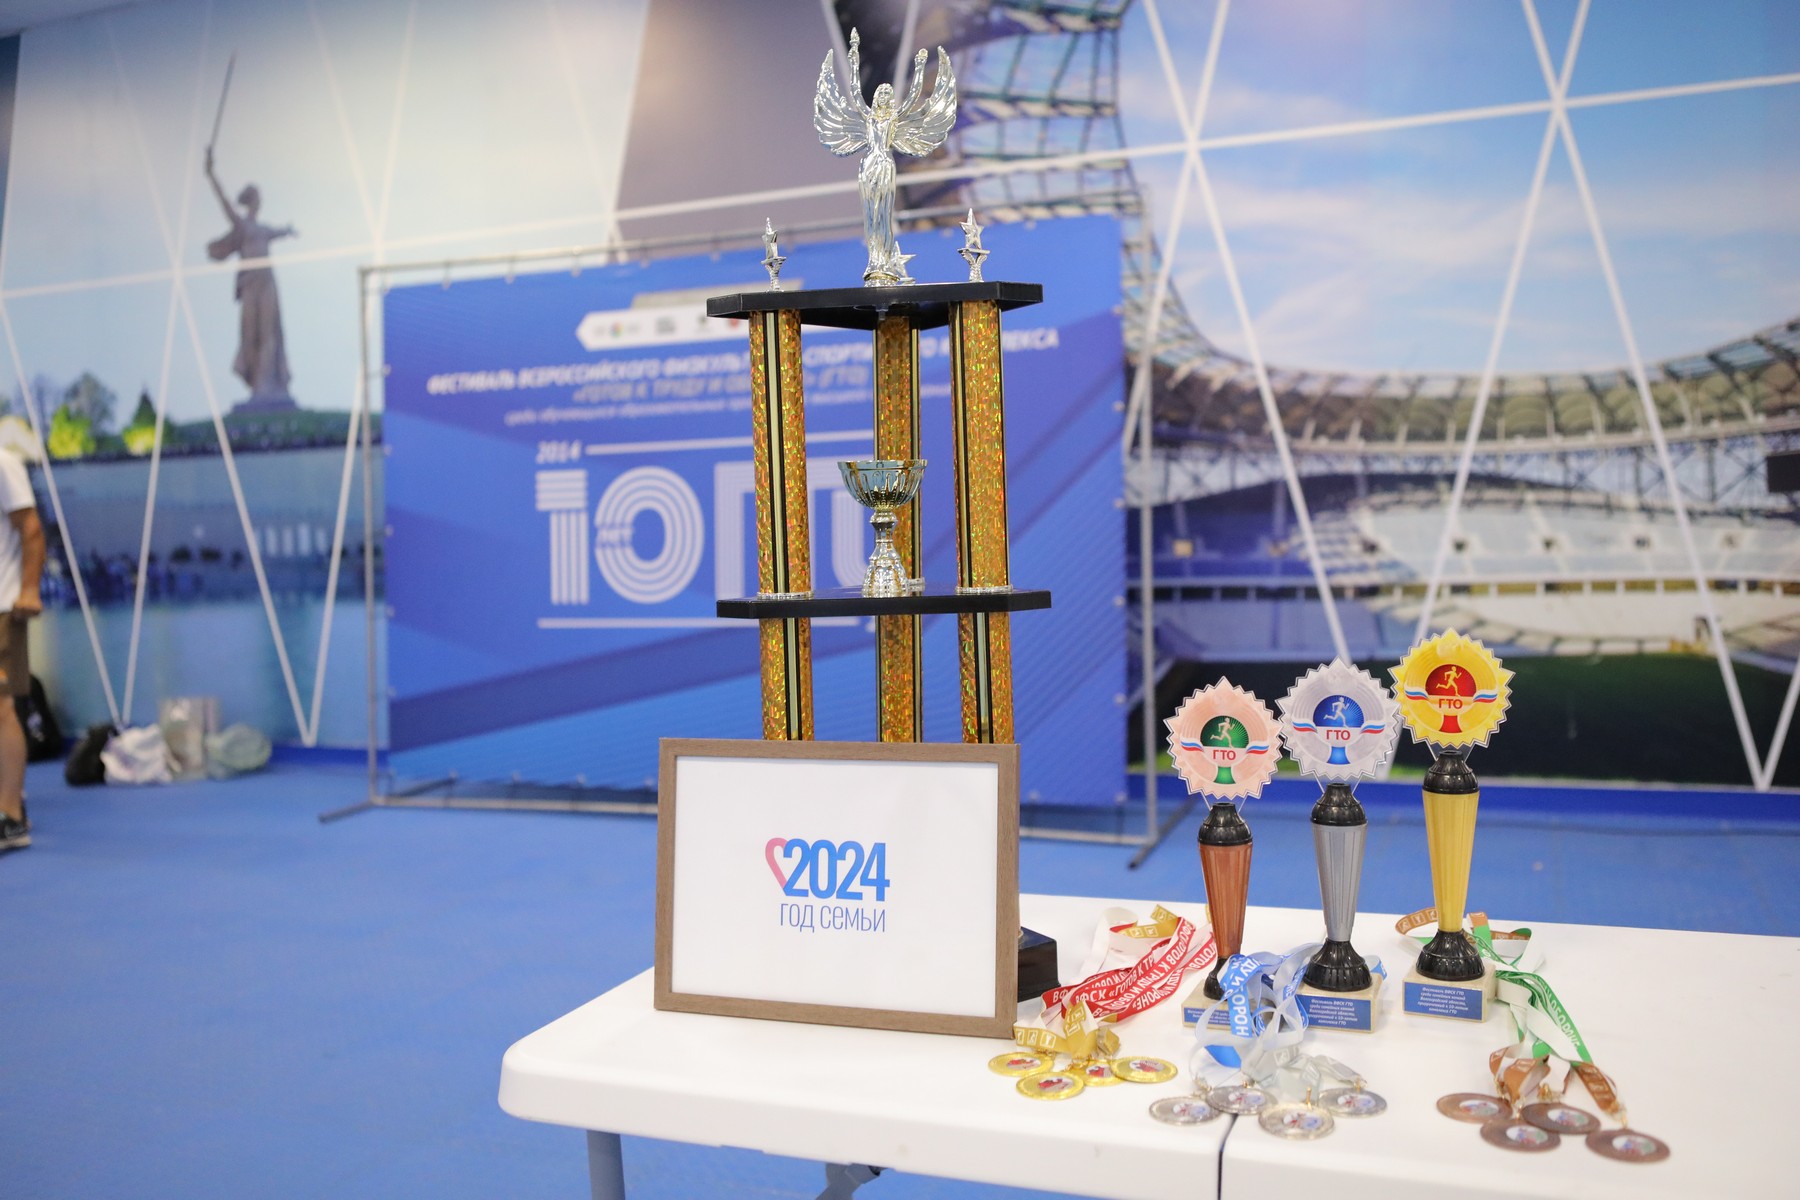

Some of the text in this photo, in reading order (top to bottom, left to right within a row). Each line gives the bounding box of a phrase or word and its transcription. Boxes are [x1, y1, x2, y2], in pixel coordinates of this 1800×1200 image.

[1438, 698, 1463, 710] ГТО
[1326, 729, 1351, 741] ГТО
[1212, 749, 1237, 761] ГТО
[783, 838, 890, 902] 2024
[780, 903, 815, 933] ГОД
